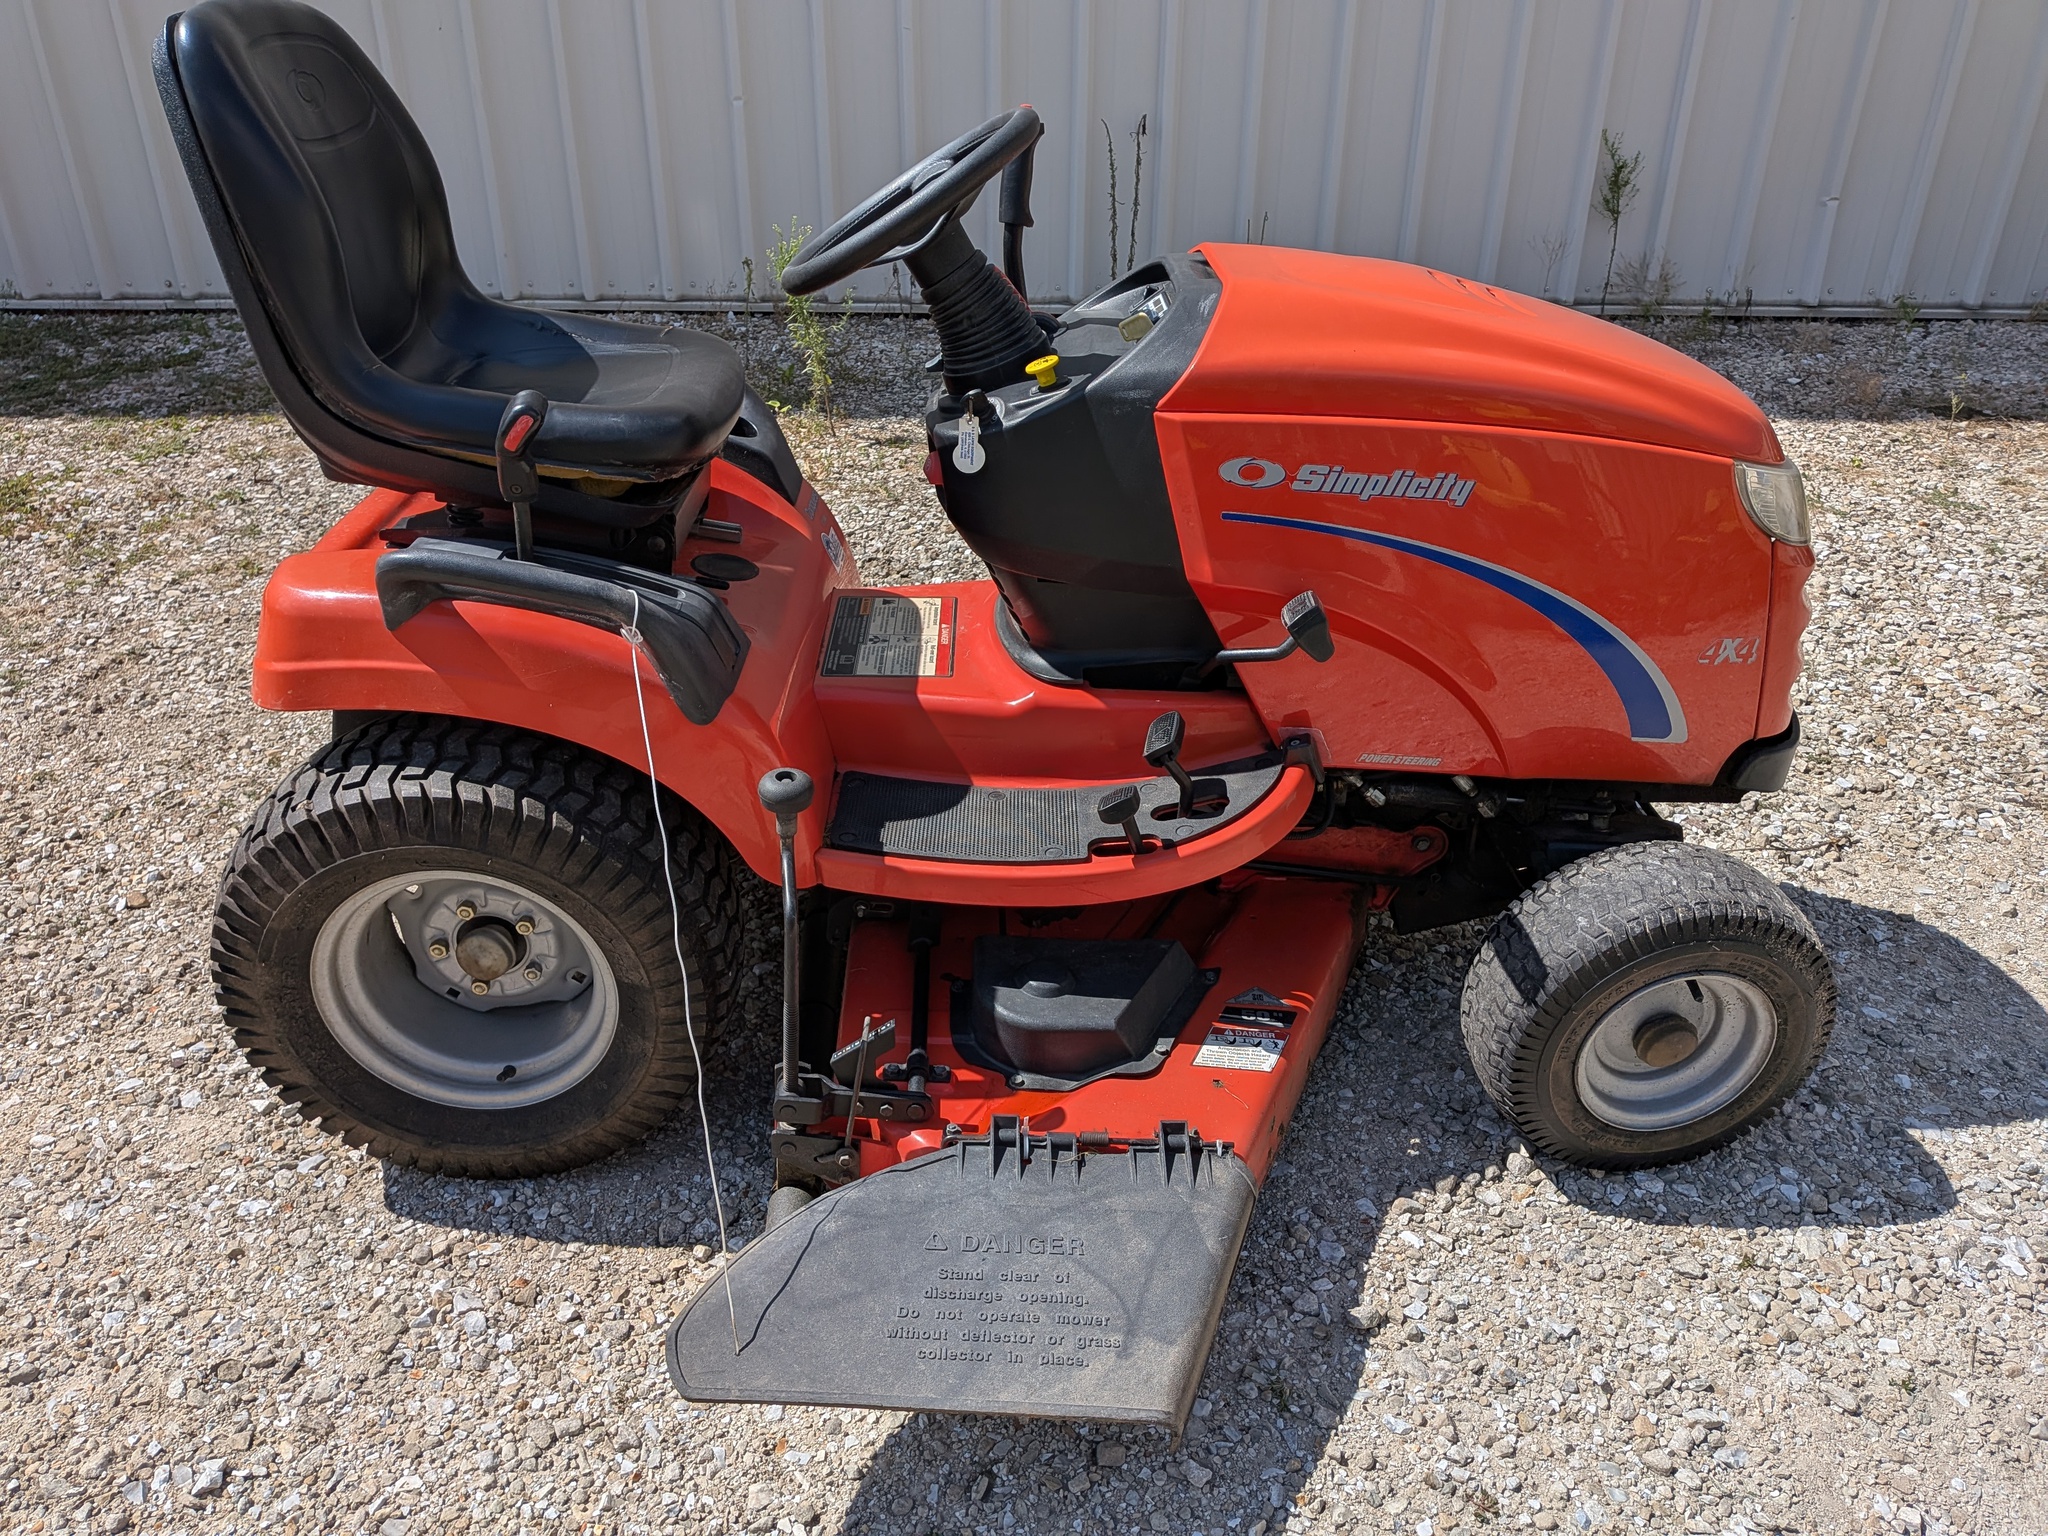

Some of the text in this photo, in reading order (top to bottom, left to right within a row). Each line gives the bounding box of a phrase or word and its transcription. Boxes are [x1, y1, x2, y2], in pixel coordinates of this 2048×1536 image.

[1291, 463, 1477, 507] Simplicity
[1358, 753, 1442, 767] POWER STEERING
[1235, 1030, 1276, 1039] DANGER
[961, 1233, 1085, 1256] DANGER
[938, 1268, 1071, 1283] Stand clear of
[923, 1286, 1090, 1307] discharge opening.
[896, 1306, 1110, 1326] Do not operate mower
[886, 1326, 1122, 1349] without deflector or grass
[916, 1347, 1090, 1367] collector in place.
